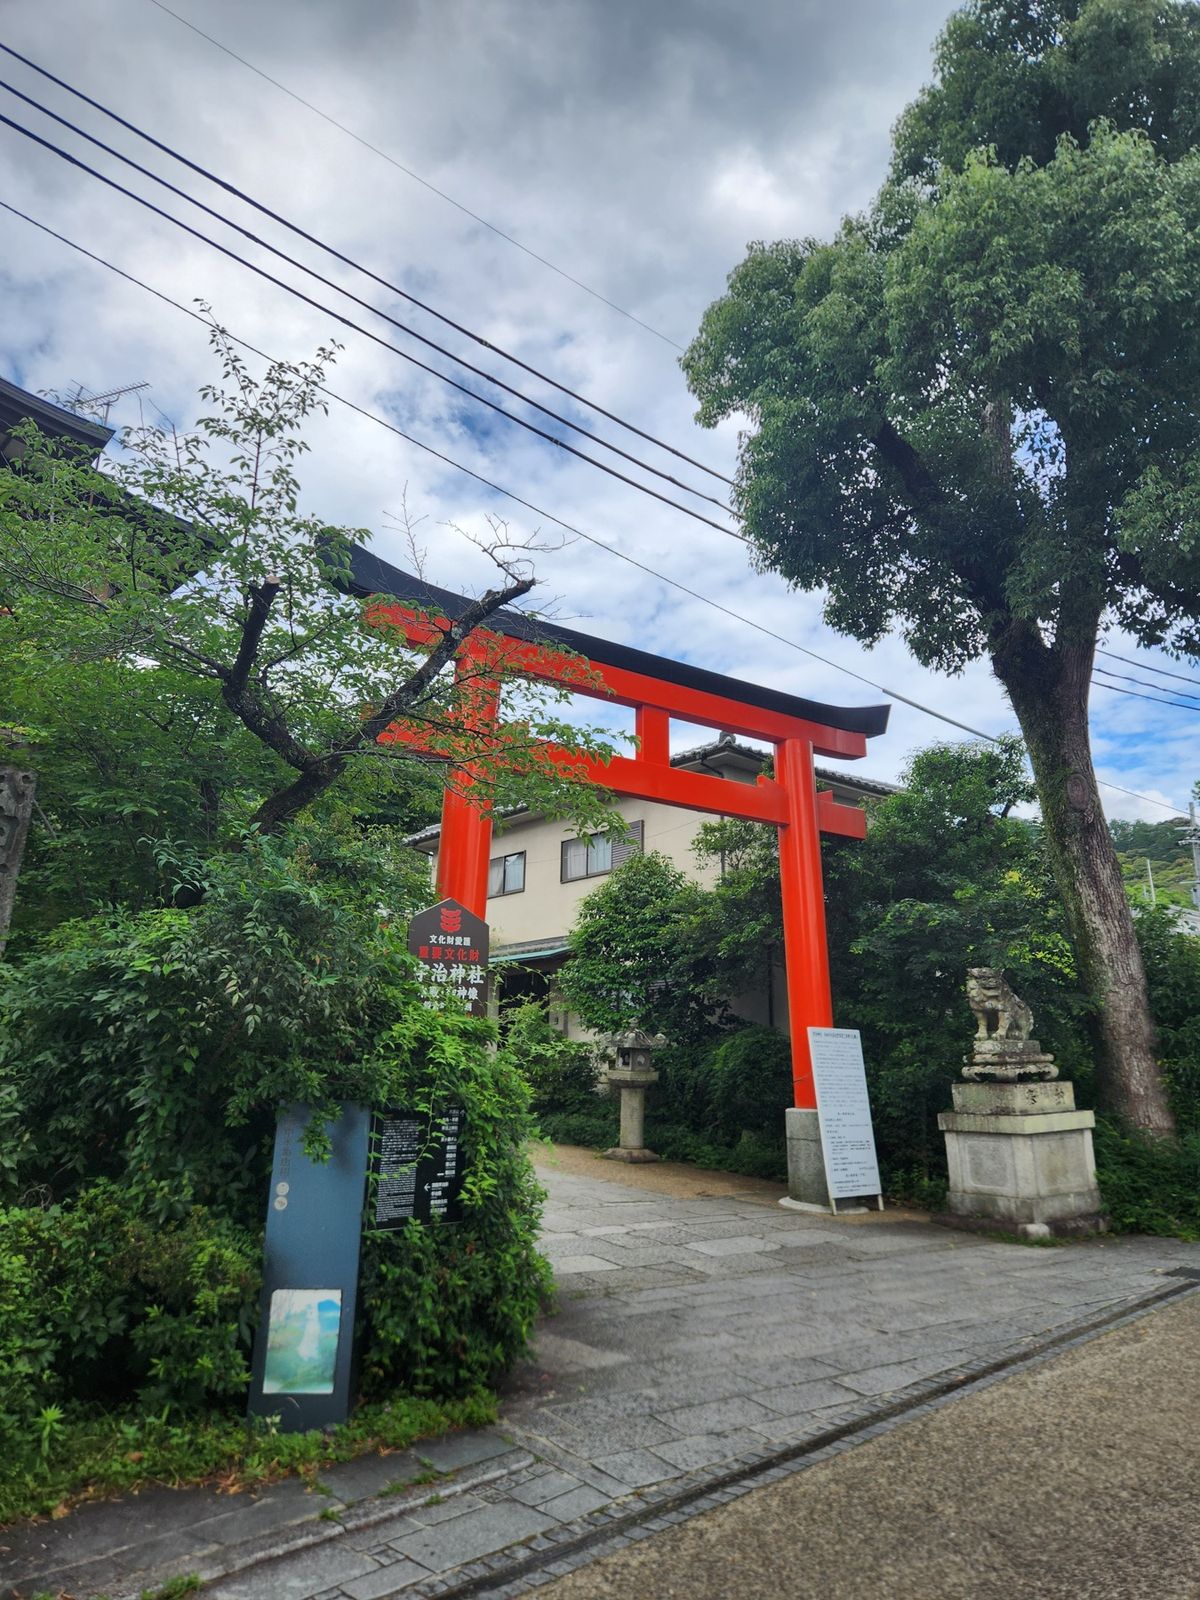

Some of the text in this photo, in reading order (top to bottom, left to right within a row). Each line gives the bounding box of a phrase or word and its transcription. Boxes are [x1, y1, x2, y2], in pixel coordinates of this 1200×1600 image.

[418, 946, 480, 961] 重要文化財
[415, 961, 484, 984] 宇治神社
